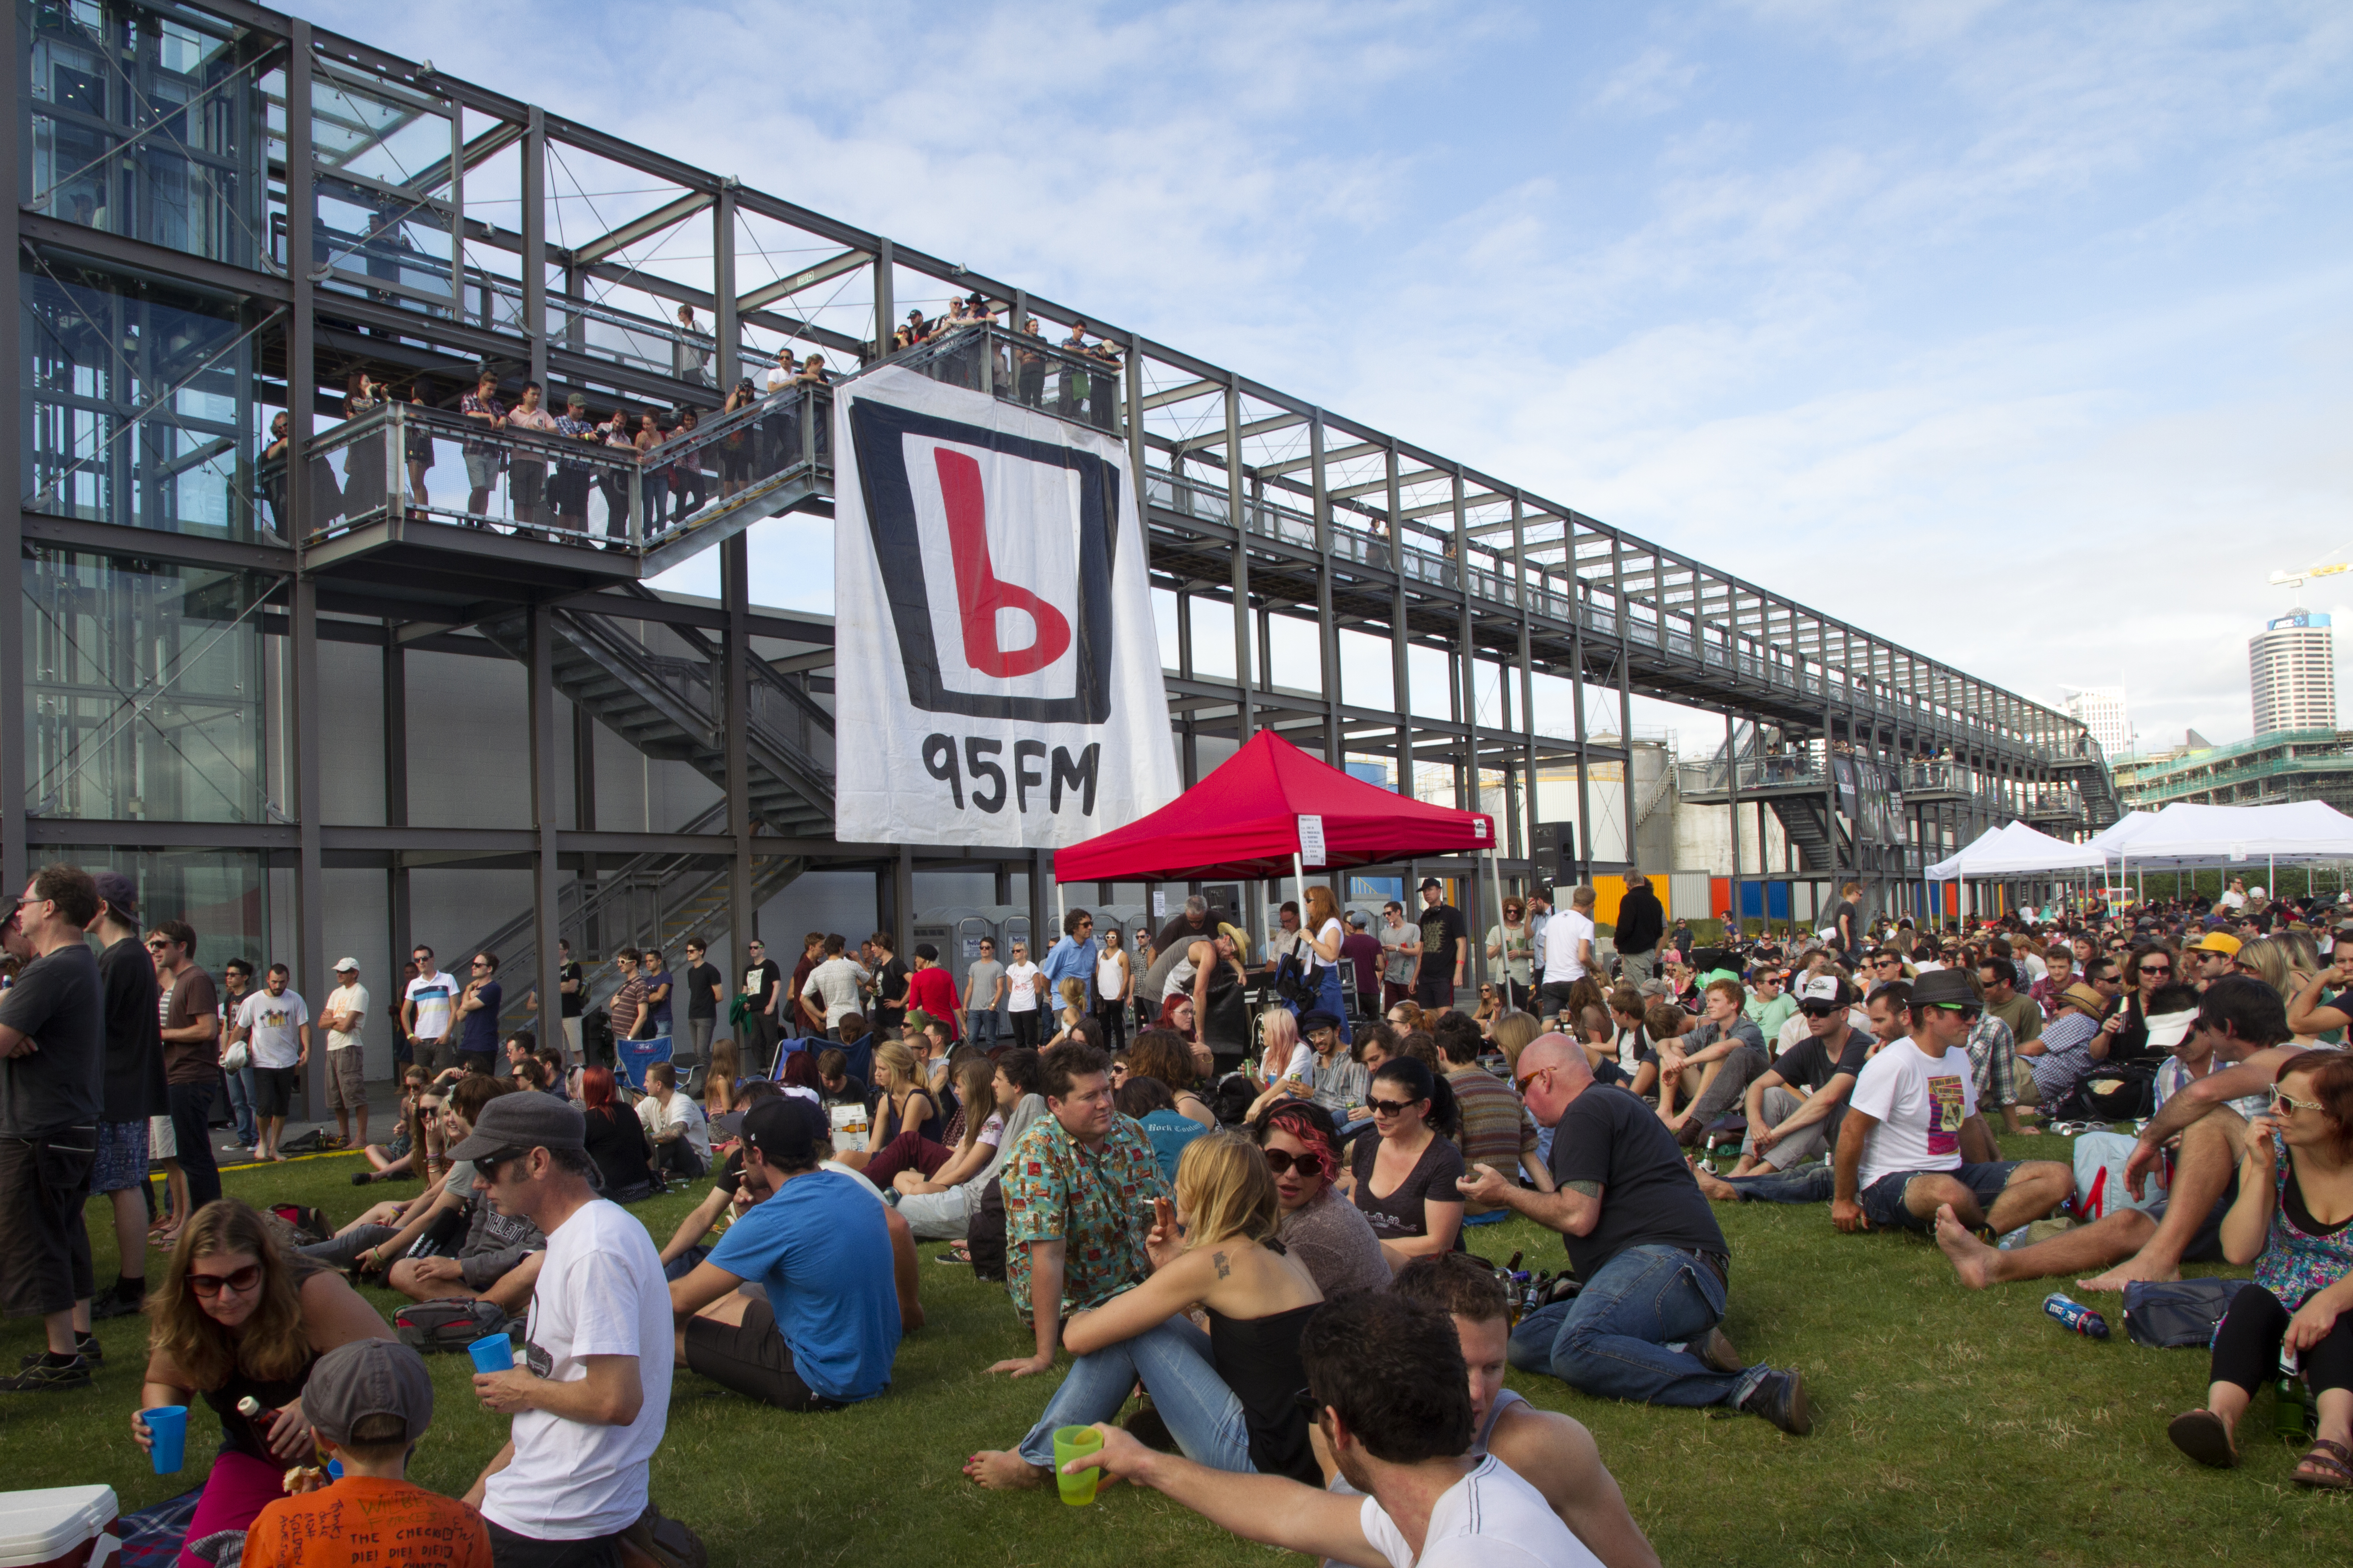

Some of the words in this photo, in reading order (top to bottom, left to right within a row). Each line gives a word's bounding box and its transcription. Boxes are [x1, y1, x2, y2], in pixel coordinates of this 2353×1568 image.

[934, 446, 1071, 678] b
[2309, 563, 2347, 577] ASB
[2273, 619, 2294, 630] ANZ
[922, 733, 1100, 816] 95FM
[1148, 1124, 1172, 1132] Rock
[487, 1211, 526, 1244] THLETI
[350, 1532, 380, 1545] THE
[396, 1527, 442, 1540] CHECKS
[351, 1549, 379, 1564] DIE!
[388, 1546, 413, 1559] DIE!
[421, 1544, 443, 1557] DIE!
